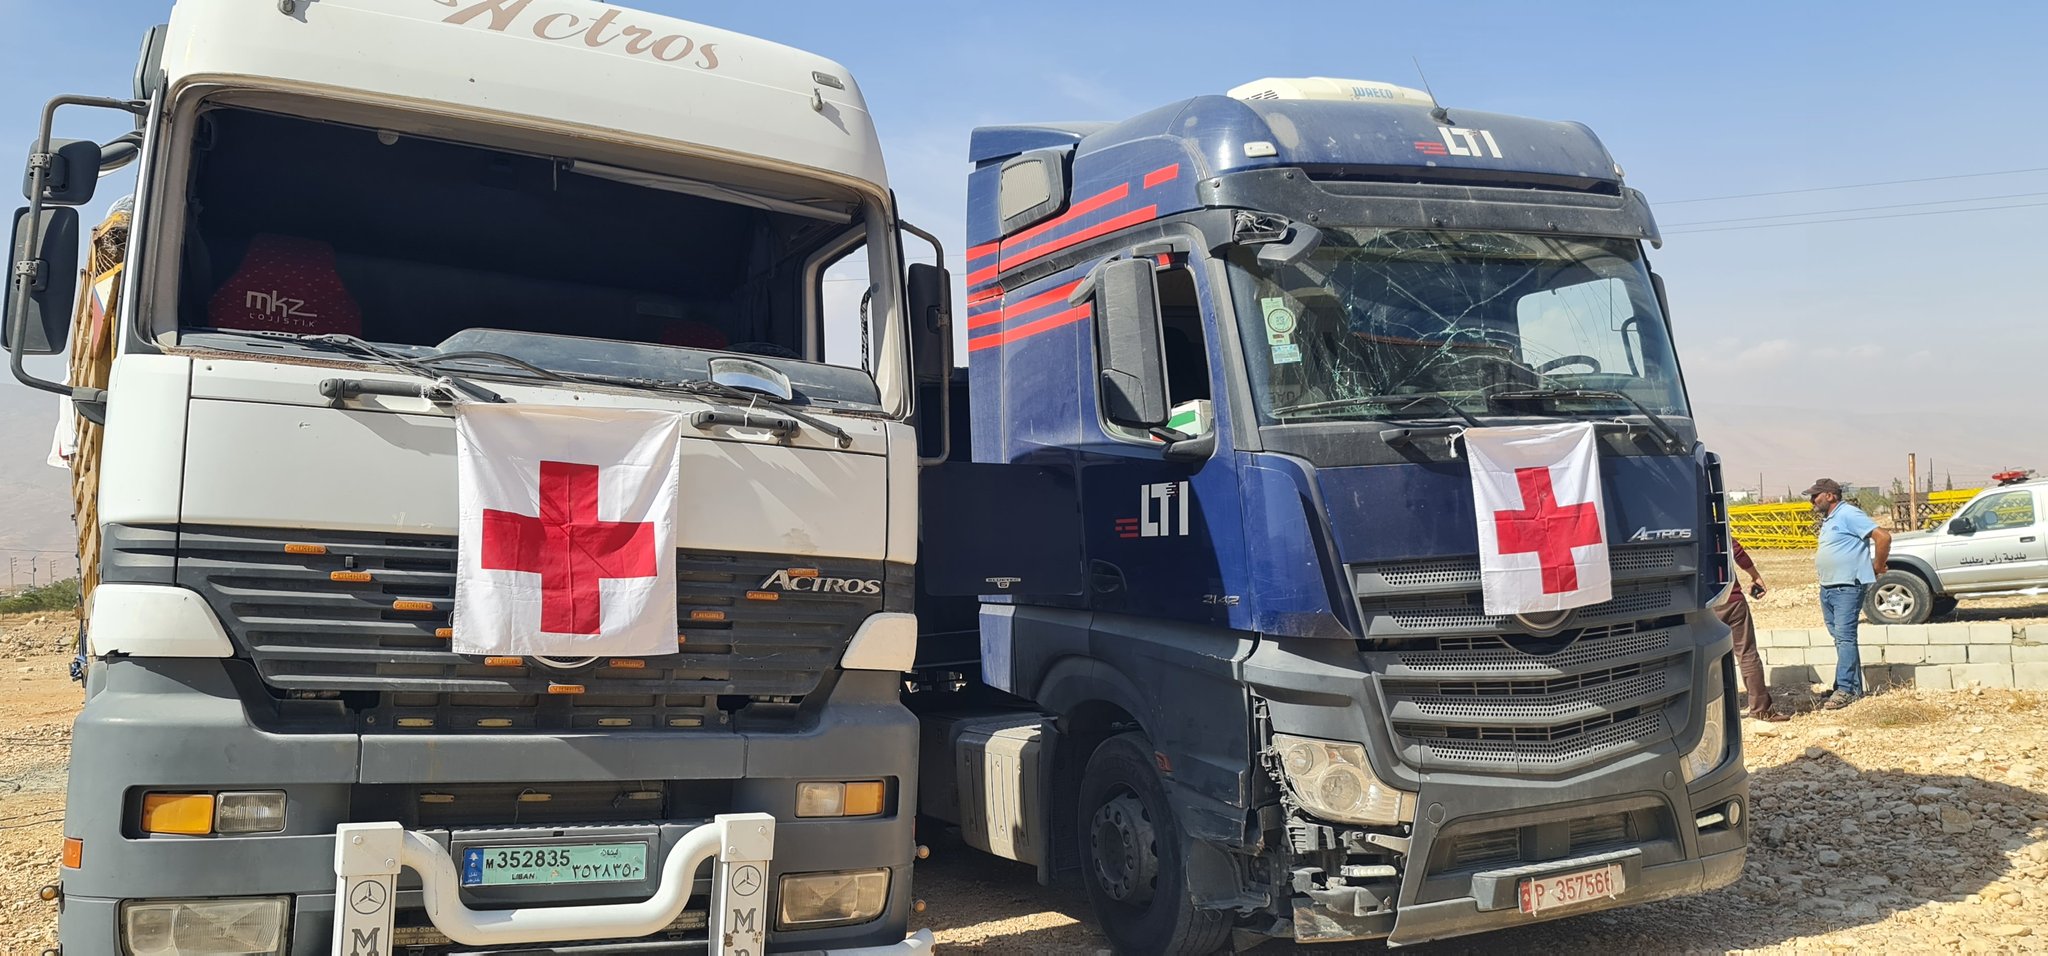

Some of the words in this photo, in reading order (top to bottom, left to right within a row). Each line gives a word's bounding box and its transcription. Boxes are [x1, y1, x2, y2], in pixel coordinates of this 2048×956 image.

[1352, 86, 1393, 99] WAECO
[1438, 127, 1503, 159] LTI
[1141, 481, 1189, 537] LTI
[1960, 557, 1984, 565] بعلبك
[2003, 552, 2027, 562] بلدية
[497, 849, 571, 869] 352835
[1535, 884, 1544, 906] P
